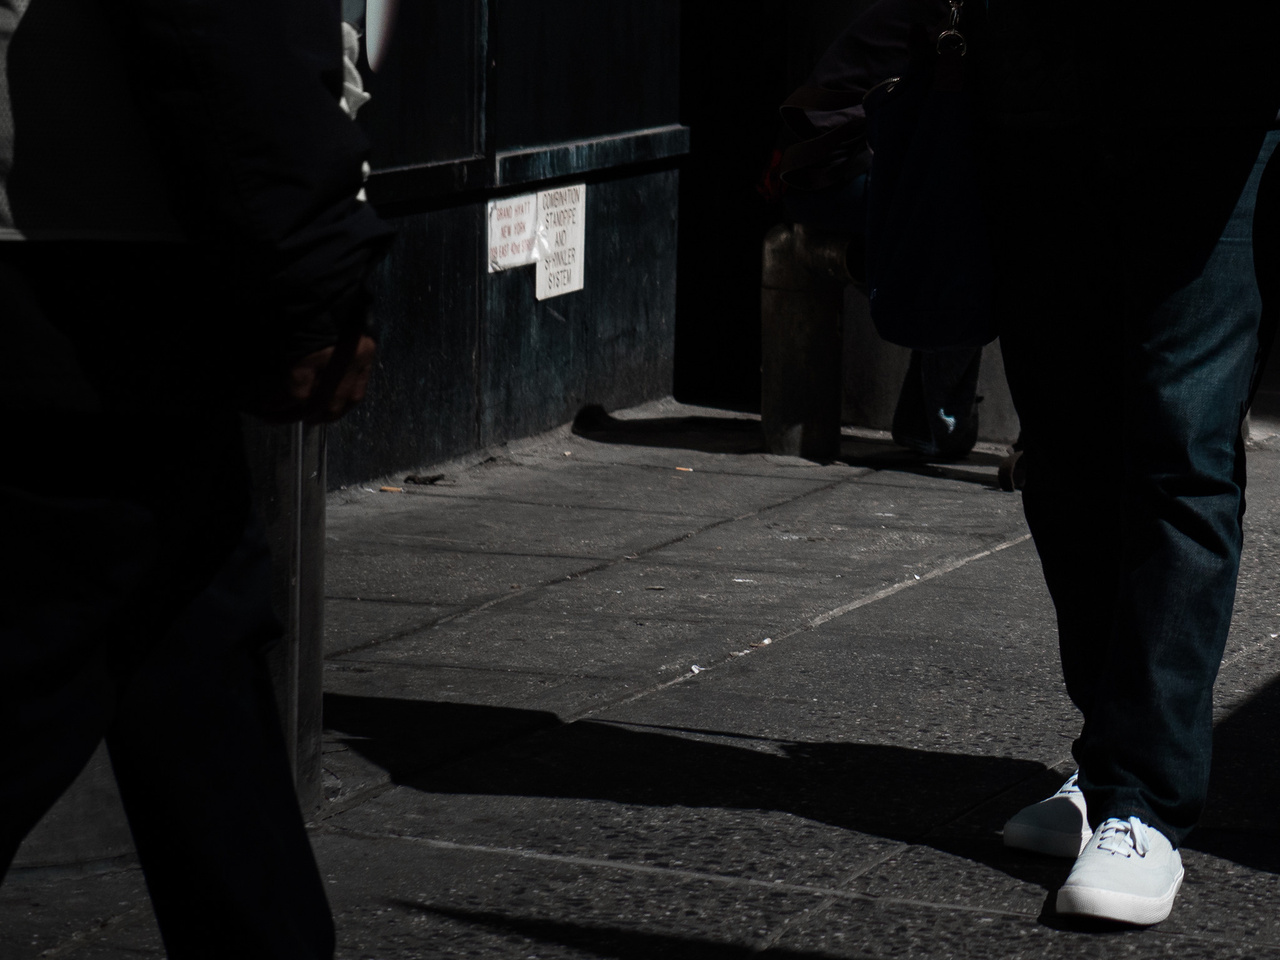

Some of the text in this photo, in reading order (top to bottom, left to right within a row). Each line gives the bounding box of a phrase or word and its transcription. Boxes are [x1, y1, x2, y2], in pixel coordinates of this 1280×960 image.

[542, 187, 580, 211] COMBINATION
[497, 202, 530, 221] GRAND HYATT
[545, 208, 577, 230] STANDPIPE
[501, 221, 526, 239] NEW YORK
[555, 230, 567, 248] AND
[548, 269, 572, 290] SYSTEM
